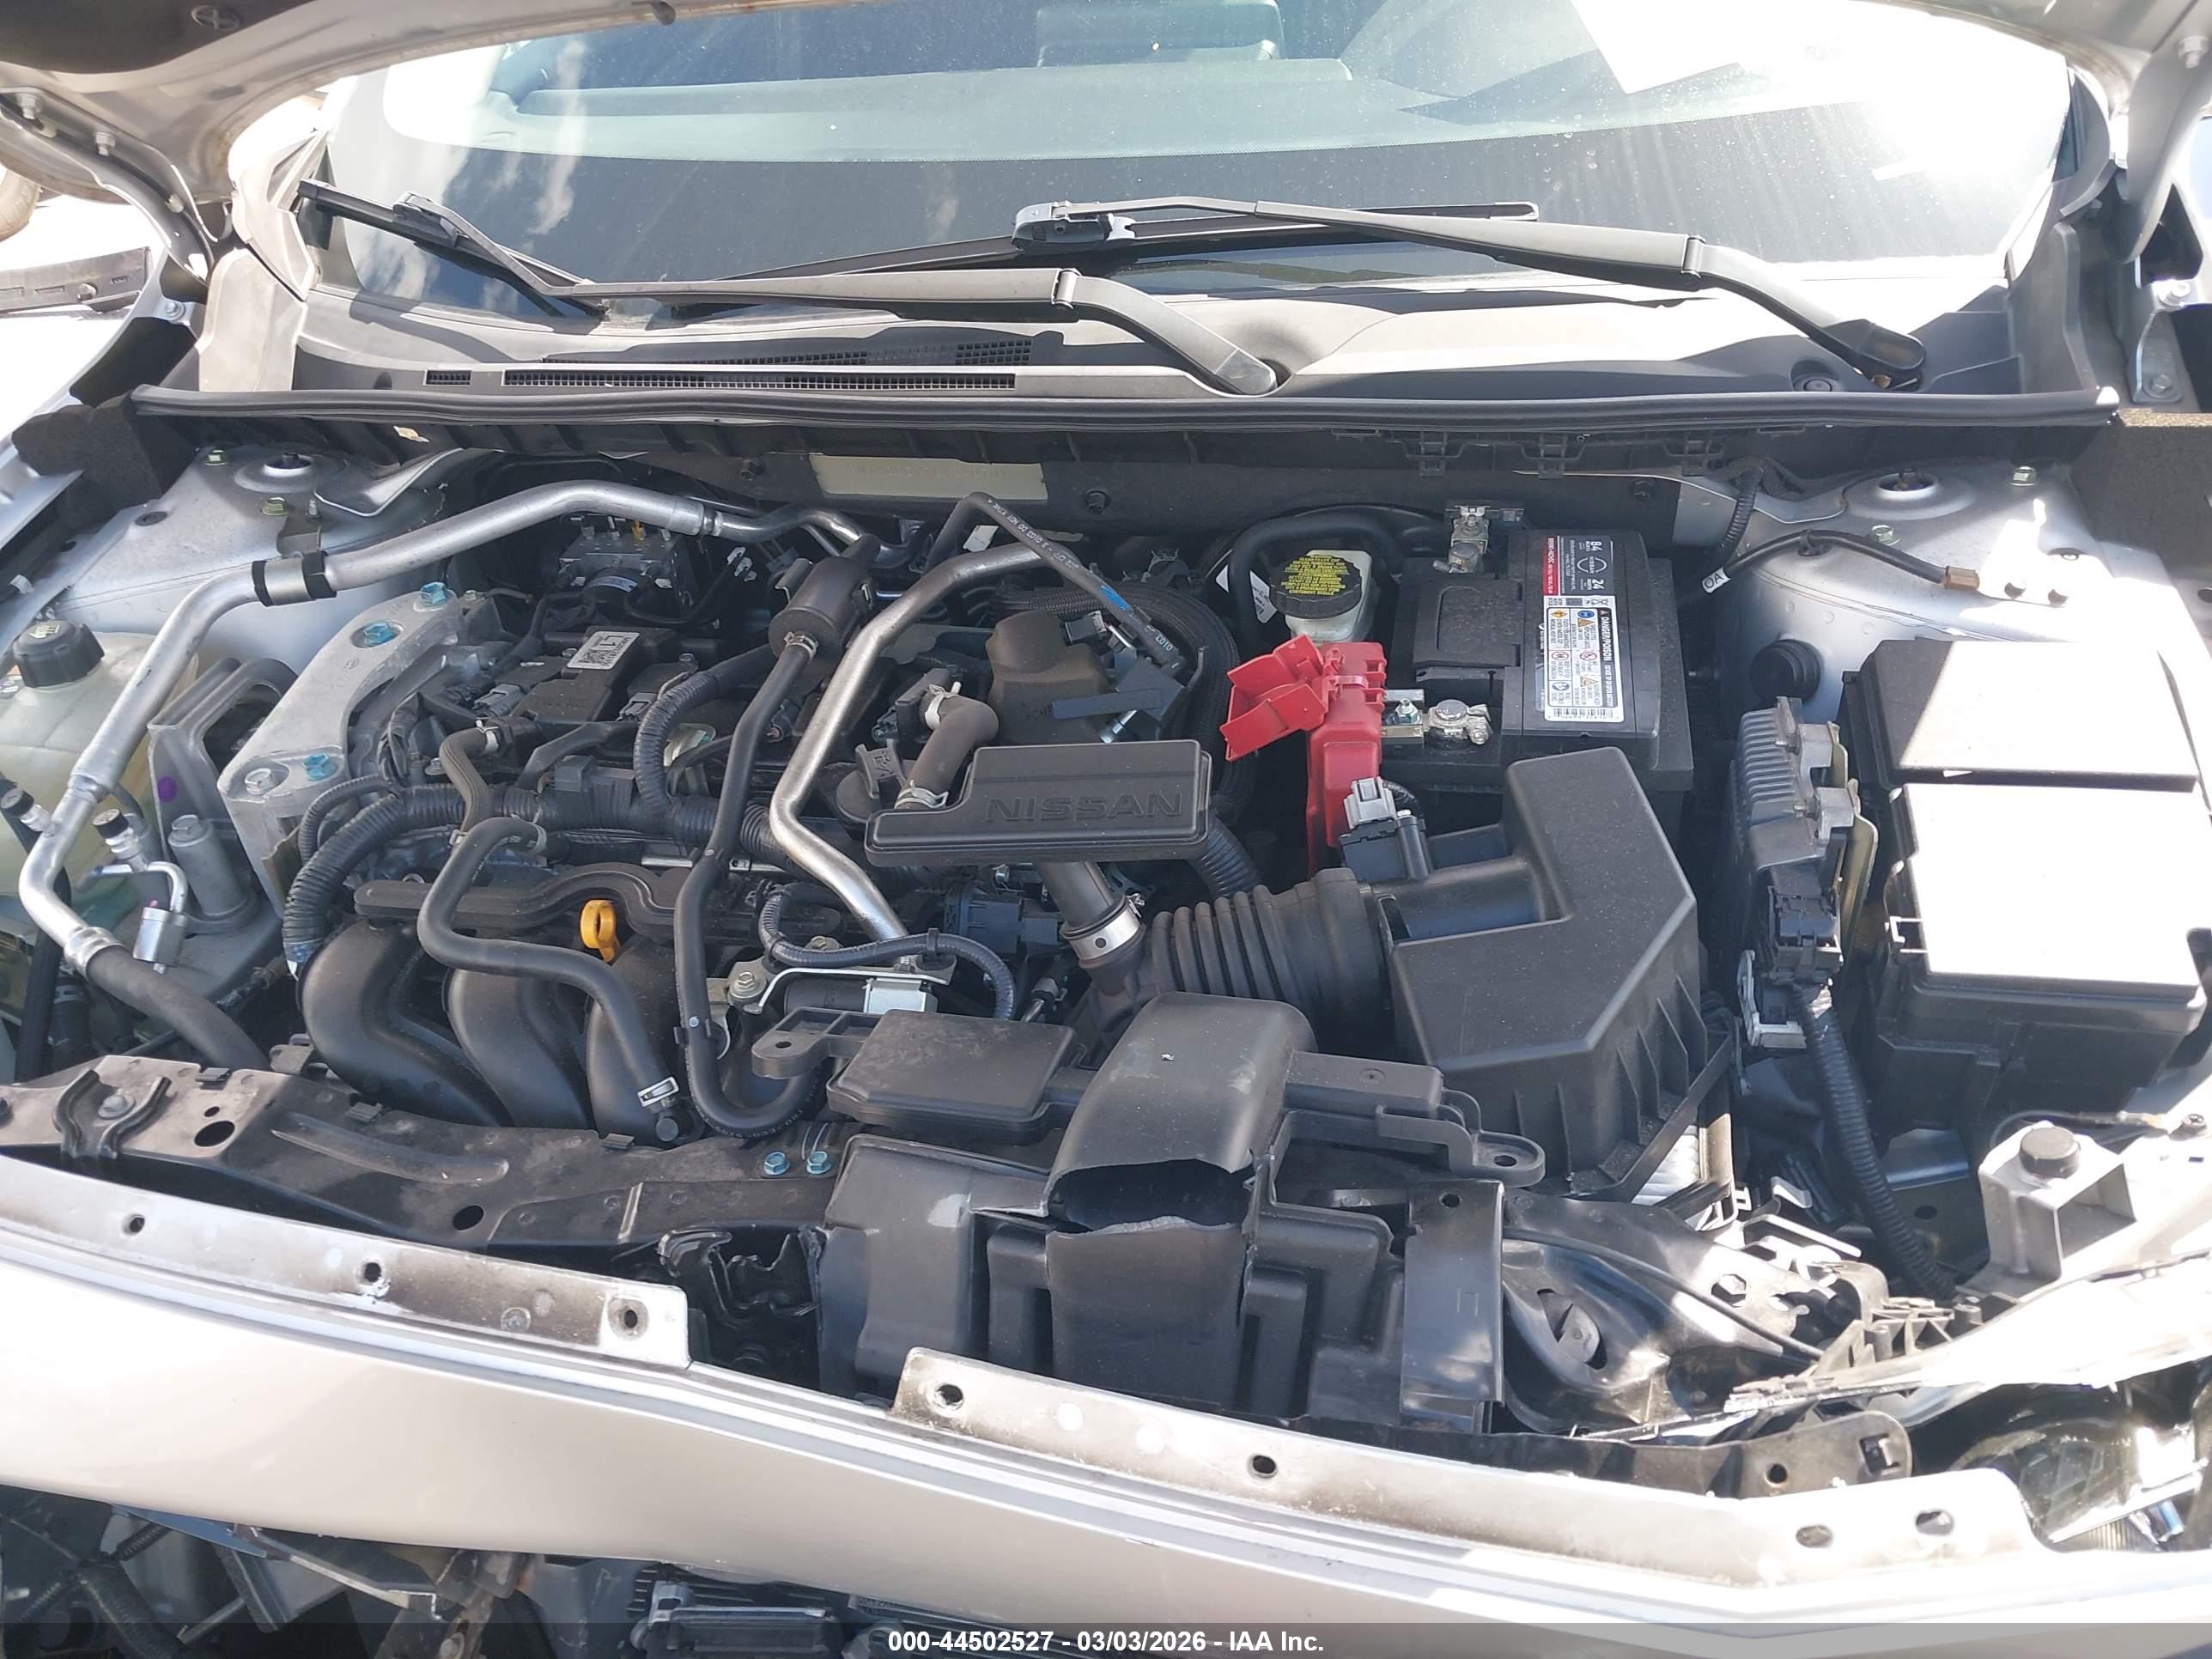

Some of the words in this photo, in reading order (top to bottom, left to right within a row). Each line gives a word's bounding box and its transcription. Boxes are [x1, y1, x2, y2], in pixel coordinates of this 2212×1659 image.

[1592, 579, 1604, 590] 24
[1155, 634, 1173, 651] 0103
[986, 793, 1183, 823] NISSAN
